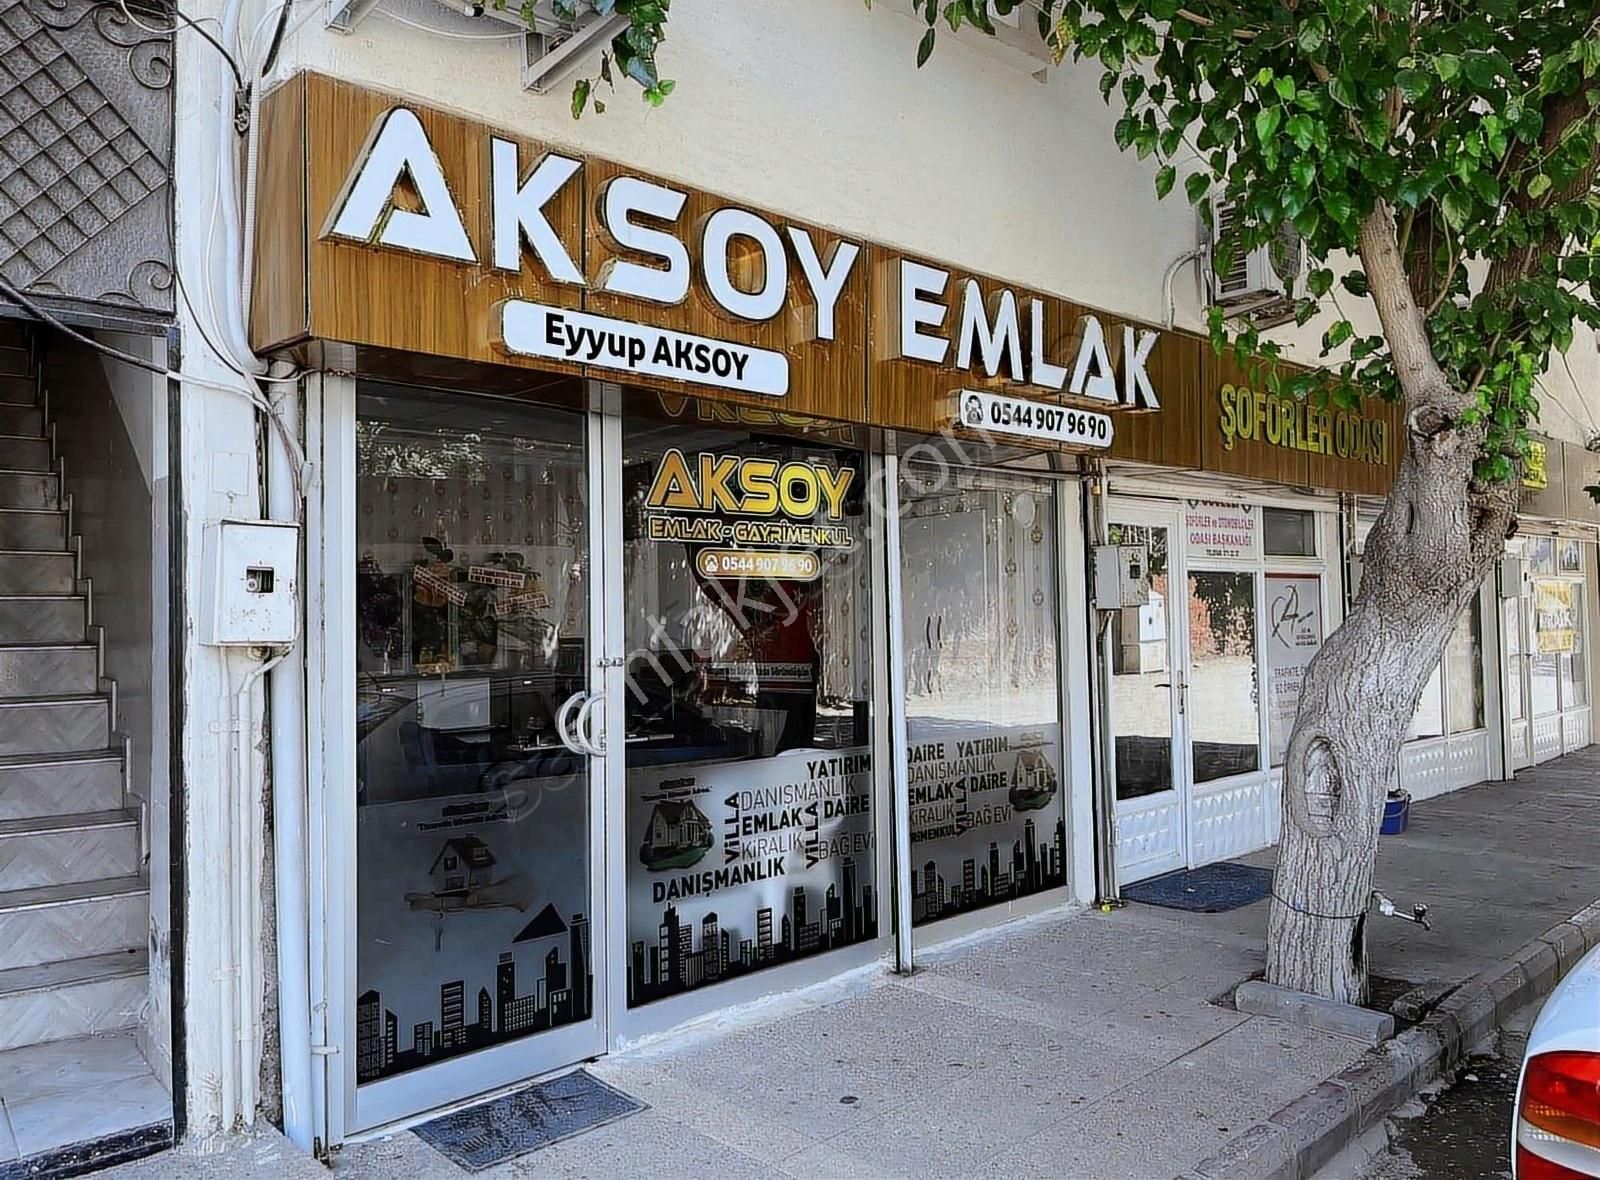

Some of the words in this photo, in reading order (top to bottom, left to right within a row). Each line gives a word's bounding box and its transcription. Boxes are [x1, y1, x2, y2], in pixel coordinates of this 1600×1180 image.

[331, 105, 861, 341] AKSOY
[546, 312, 645, 367] Eyyup
[652, 336, 749, 380] AKSOY
[901, 258, 1161, 410] EMLAK
[991, 401, 1032, 428] 0544
[1036, 407, 1064, 432] 907
[1336, 410, 1388, 466] ODASI
[646, 449, 855, 521] AKSOY
[721, 556, 753, 571] 0544
[806, 754, 871, 780] YATIRIM
[741, 775, 856, 812] DANIŞMANLIK
[908, 782, 955, 806] EMLAK
[742, 807, 803, 836] EMLAK
[653, 856, 786, 904] DANIŞMANLIK
